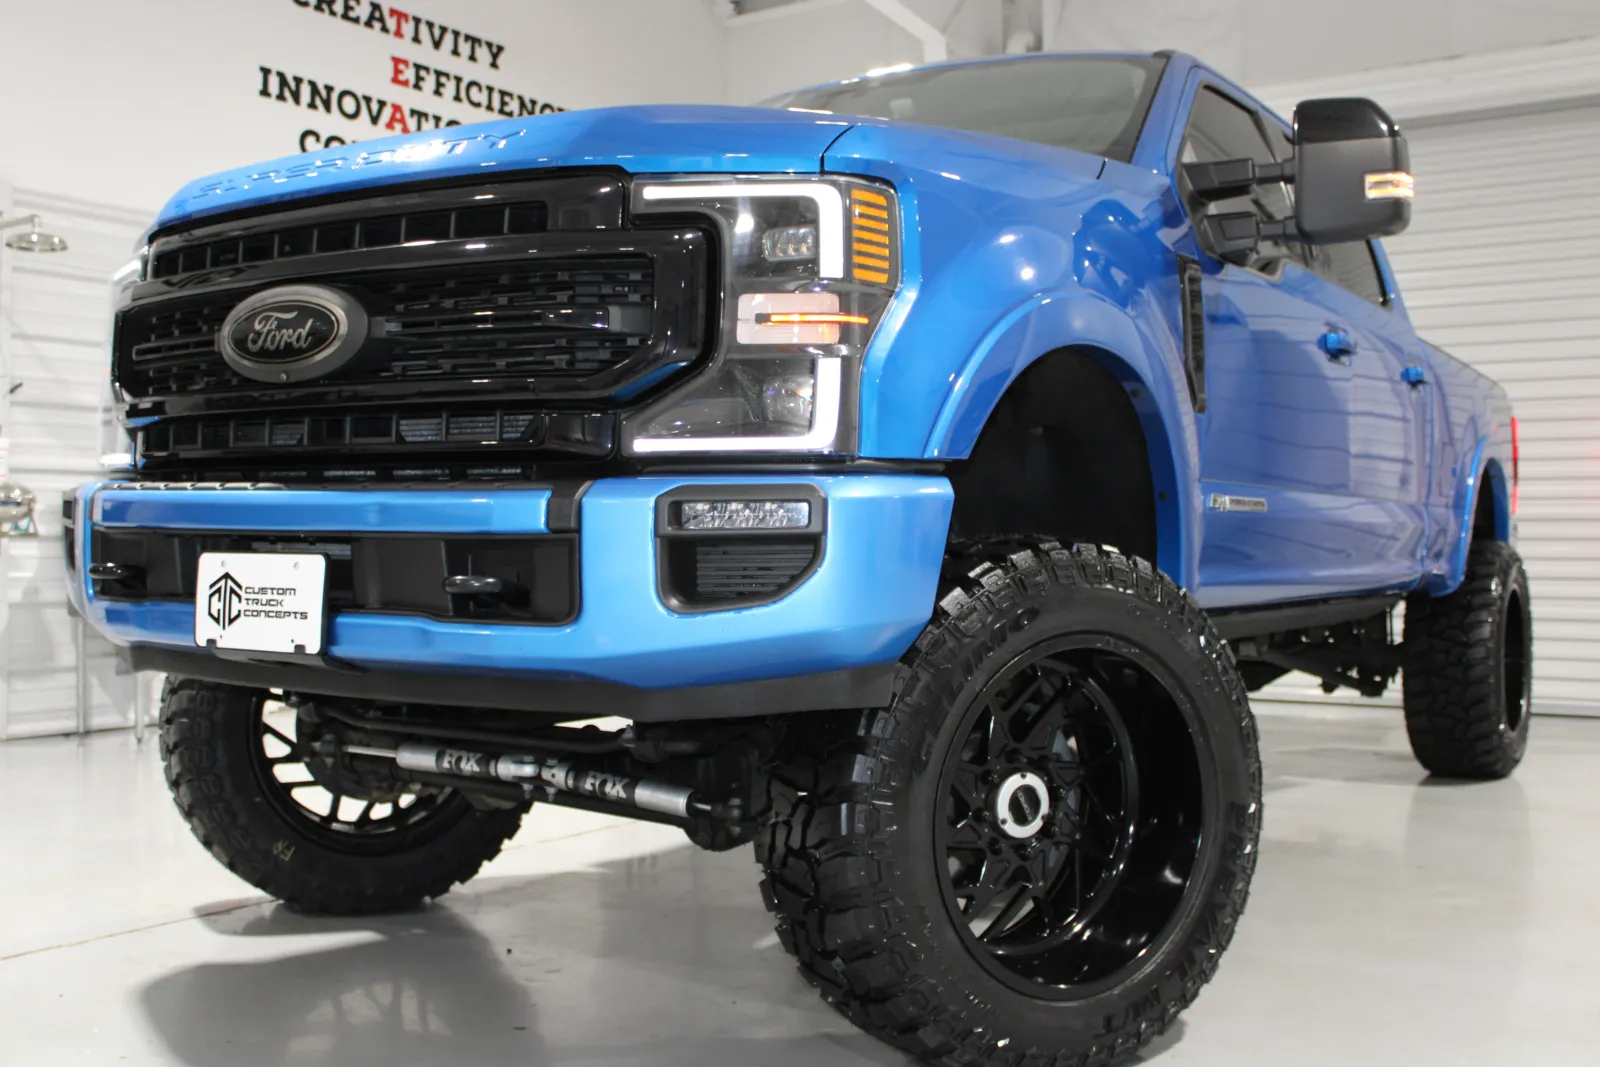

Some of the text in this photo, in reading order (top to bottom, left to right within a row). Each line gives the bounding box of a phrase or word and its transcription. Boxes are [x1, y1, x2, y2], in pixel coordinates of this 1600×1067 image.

[248, 311, 314, 352] Ford
[245, 586, 296, 596] CUSTOM
[245, 598, 284, 607] TRUCK
[243, 609, 308, 620] CONCEPTS
[442, 750, 483, 777] FOX
[584, 770, 630, 801] FOX
